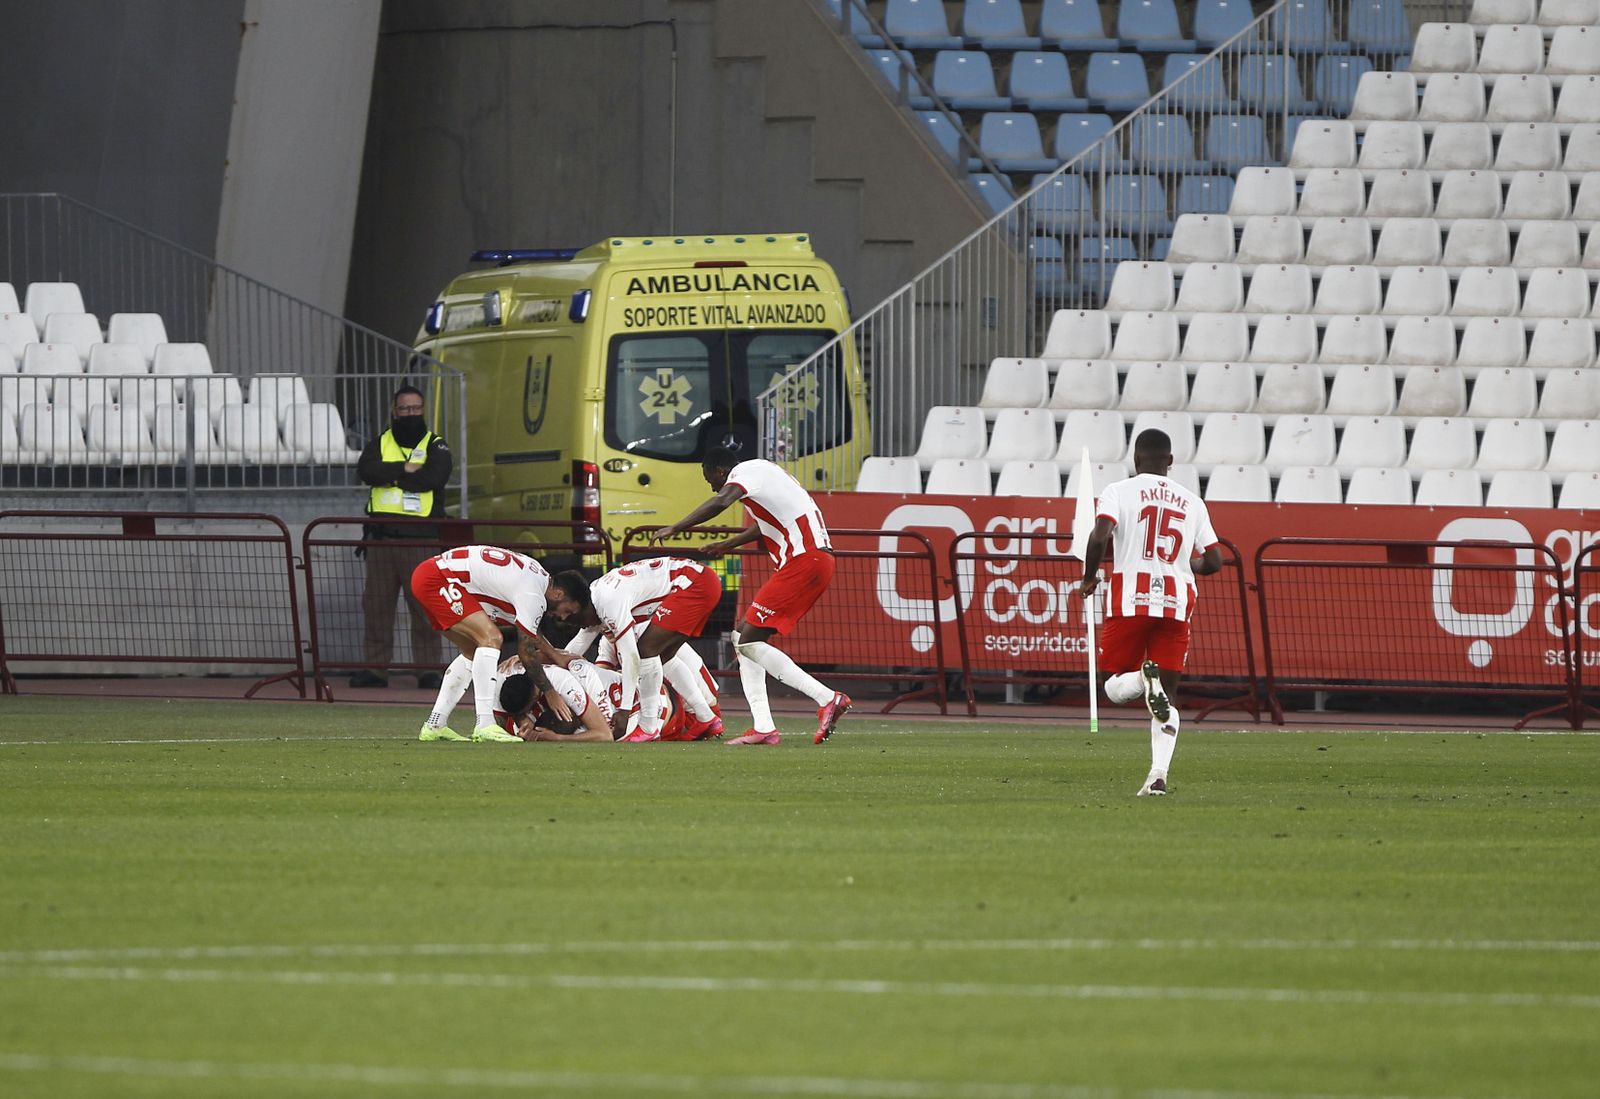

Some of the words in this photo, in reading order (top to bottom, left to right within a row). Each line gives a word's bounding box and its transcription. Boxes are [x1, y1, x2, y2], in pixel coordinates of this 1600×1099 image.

[626, 273, 821, 295] AMBULANCIA
[624, 306, 697, 328] SOPORTE
[701, 305, 743, 325] VITAL
[747, 303, 825, 325] AVANZADO
[659, 374, 672, 389] U
[652, 391, 680, 407] 24
[1140, 487, 1189, 512] AKIEME
[984, 515, 1075, 575] gru
[1138, 504, 1187, 565] 15
[1544, 528, 1600, 589] gr
[439, 583, 463, 604] 16
[1544, 592, 1600, 638] co
